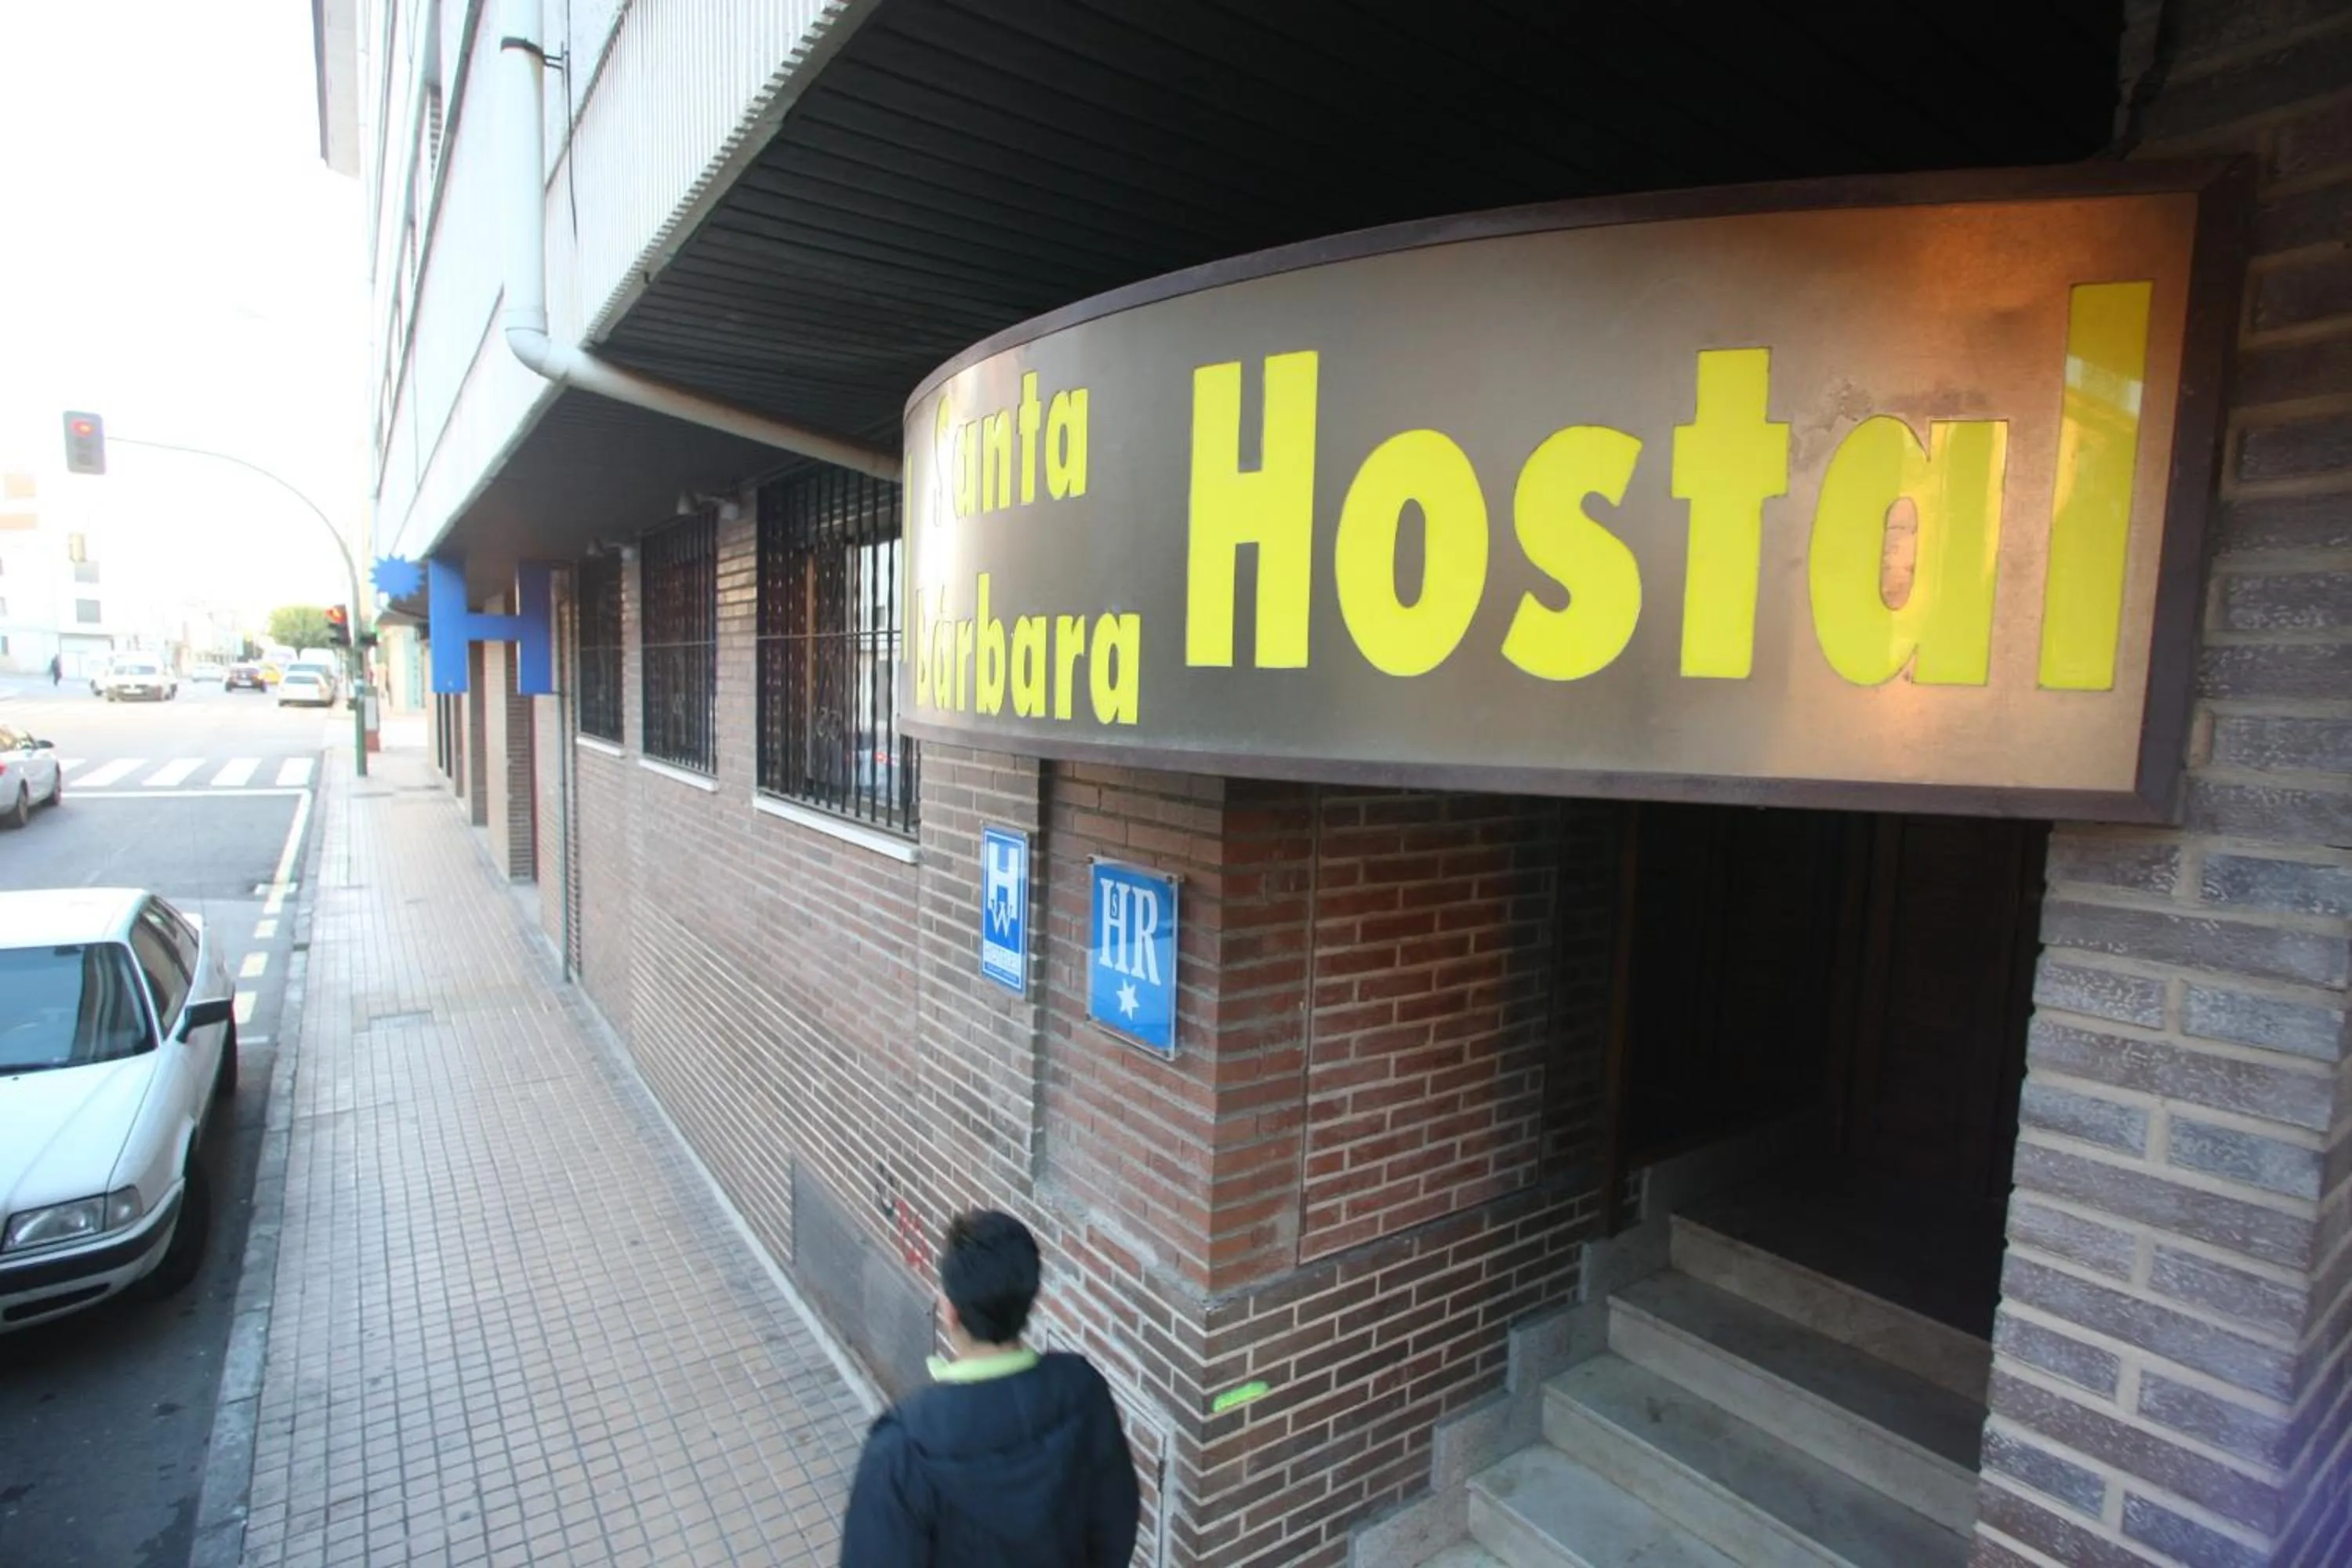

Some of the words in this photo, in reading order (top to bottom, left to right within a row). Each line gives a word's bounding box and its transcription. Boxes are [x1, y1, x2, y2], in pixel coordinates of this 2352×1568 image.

[934, 371, 1088, 528] Santa
[1185, 281, 2152, 691] Hostal
[429, 558, 552, 694] H
